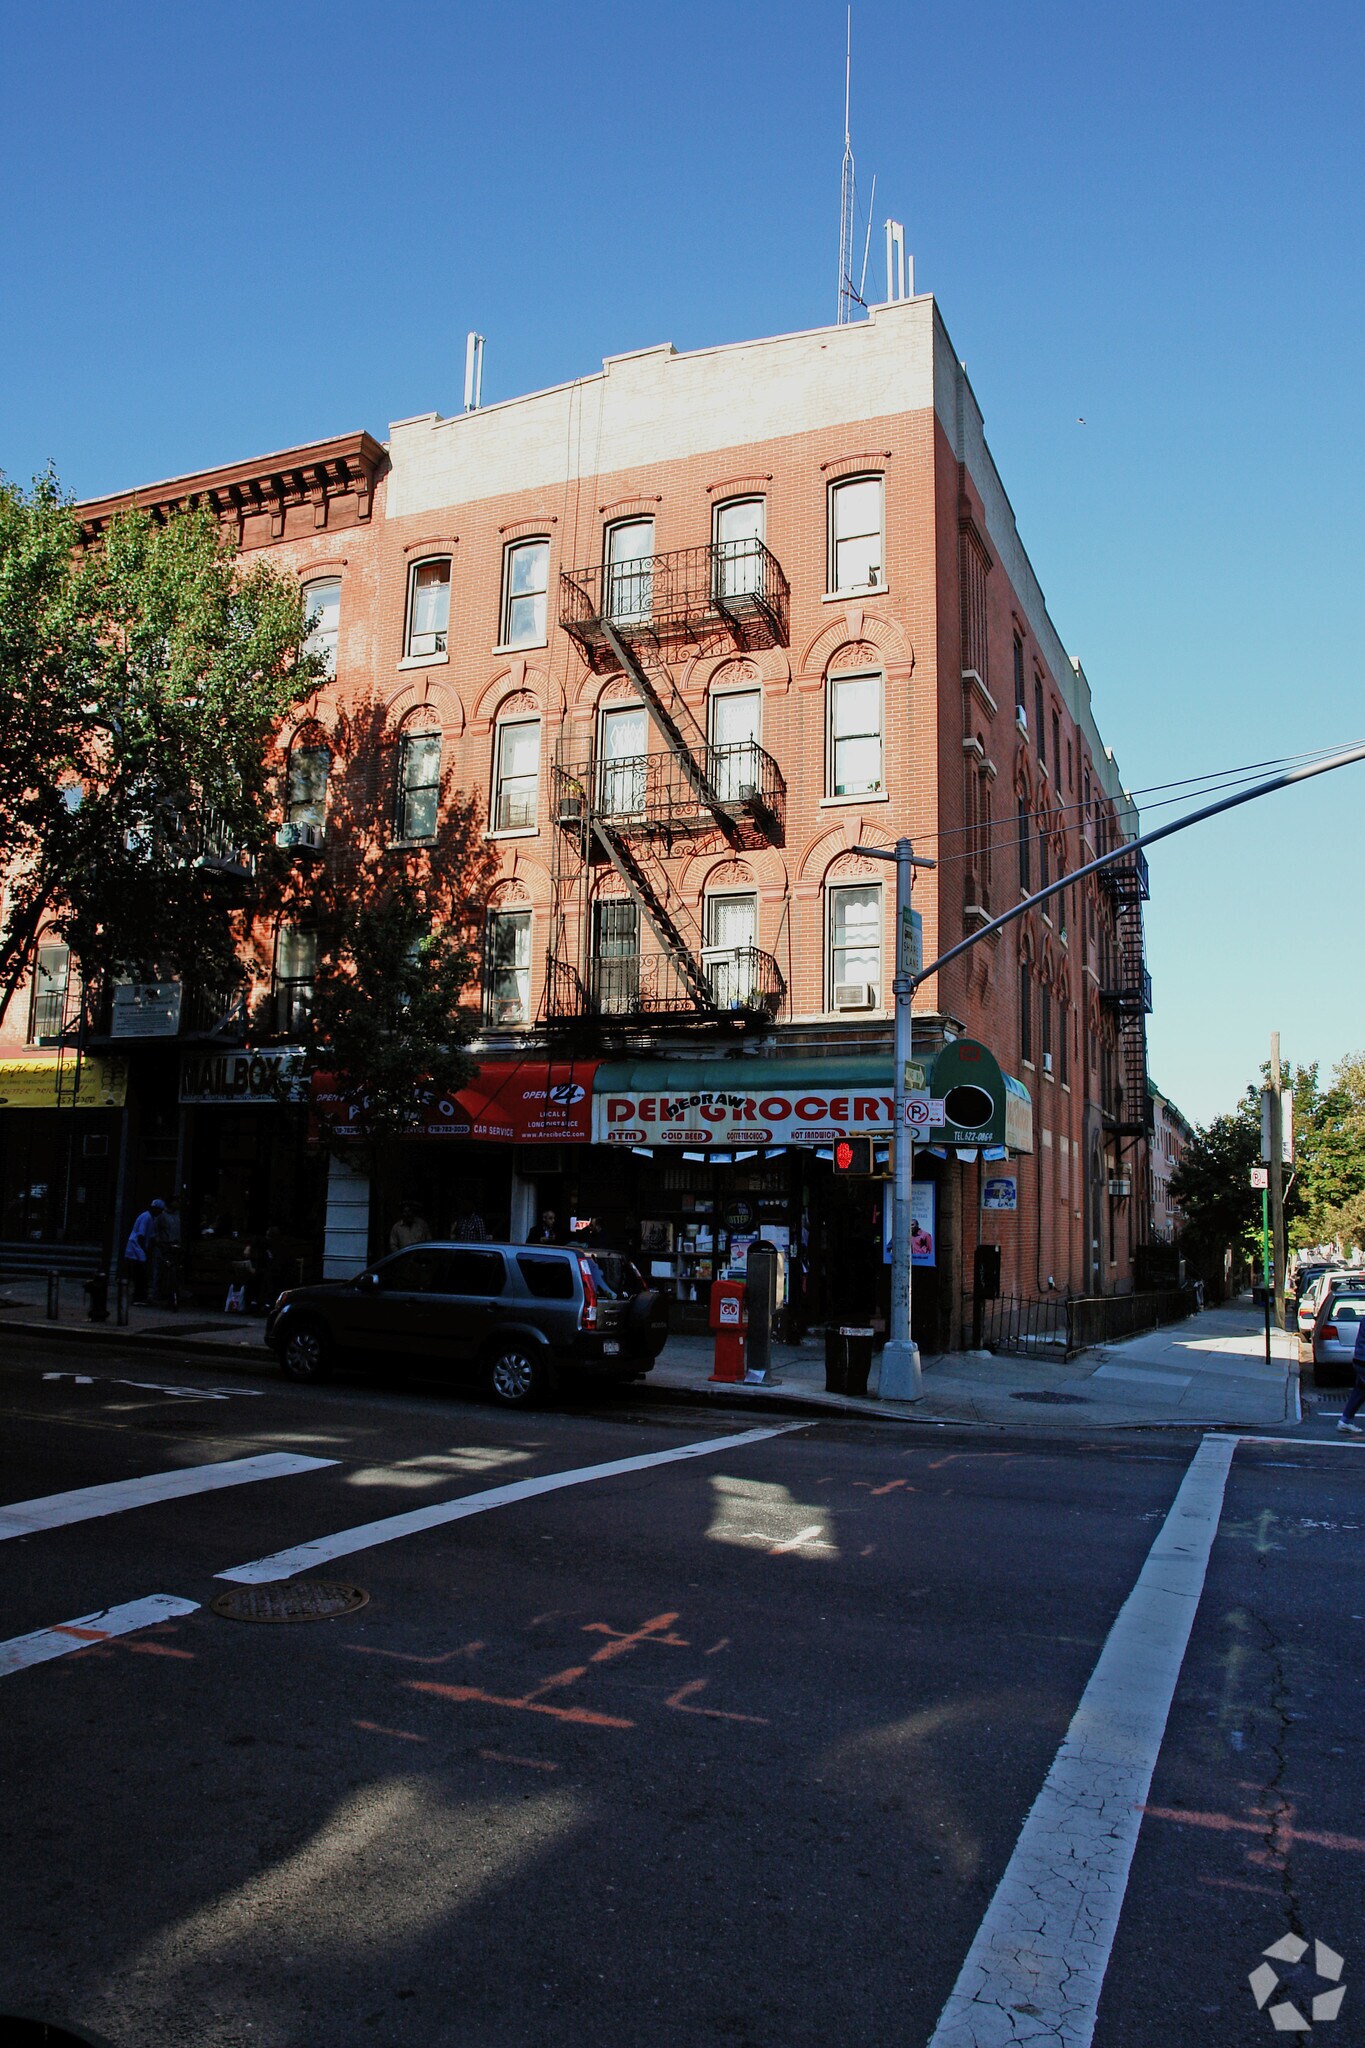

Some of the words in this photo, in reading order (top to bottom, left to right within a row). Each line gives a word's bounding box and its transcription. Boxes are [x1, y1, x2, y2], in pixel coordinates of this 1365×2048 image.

[33, 1062, 56, 1077] Eye
[522, 1090, 547, 1100] OPEN
[552, 1083, 579, 1104] 24
[699, 1096, 895, 1121] GROCERY
[473, 1124, 487, 1134] CAR
[489, 1126, 514, 1137] SERVICE
[607, 1132, 637, 1140] ATM
[661, 1132, 683, 1140] COLD
[684, 1132, 703, 1140] BEER
[790, 1131, 803, 1139] HOT
[722, 1303, 737, 1315] GO
